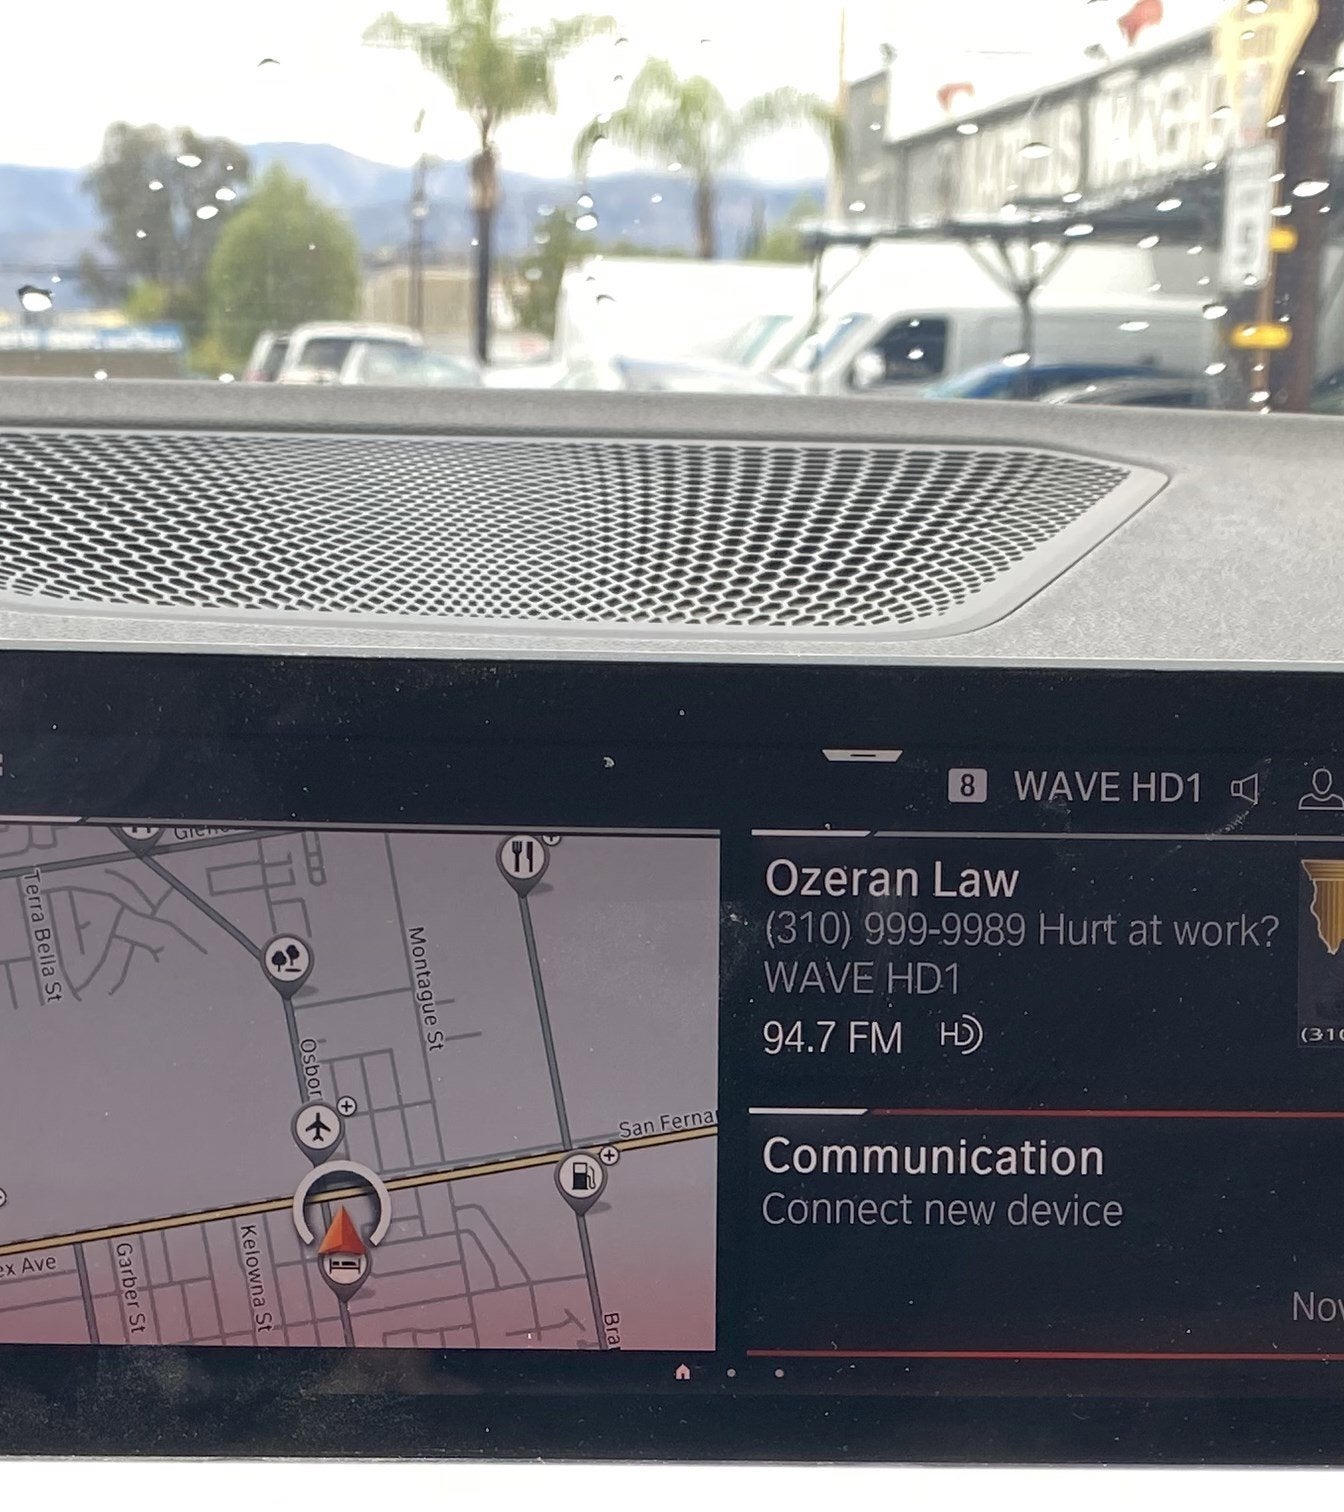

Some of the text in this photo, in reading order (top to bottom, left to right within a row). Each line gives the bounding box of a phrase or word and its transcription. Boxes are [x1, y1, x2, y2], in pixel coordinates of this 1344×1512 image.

[961, 774, 975, 797] 8
[1014, 771, 1199, 802] WAVE HD1
[767, 859, 1019, 897] Ozeran Law
[23, 869, 61, 1002] Terra Bella St
[767, 910, 1279, 949] (310) 999-9989 Hurt at work?
[409, 927, 444, 1051] Montague St
[764, 961, 957, 994] WAVE HD1
[764, 1021, 835, 1054] 94.7
[850, 1022, 901, 1053] FM
[301, 1039, 323, 1099] Osbor
[619, 1110, 717, 1138] San Ferna
[764, 1137, 1102, 1175] Communication
[763, 1192, 1122, 1226] Connect new device
[22, 1257, 56, 1274] Ave
[241, 1225, 272, 1333] Kelowna St
[116, 1243, 146, 1333] Garber St
[604, 1313, 620, 1350] Bra
